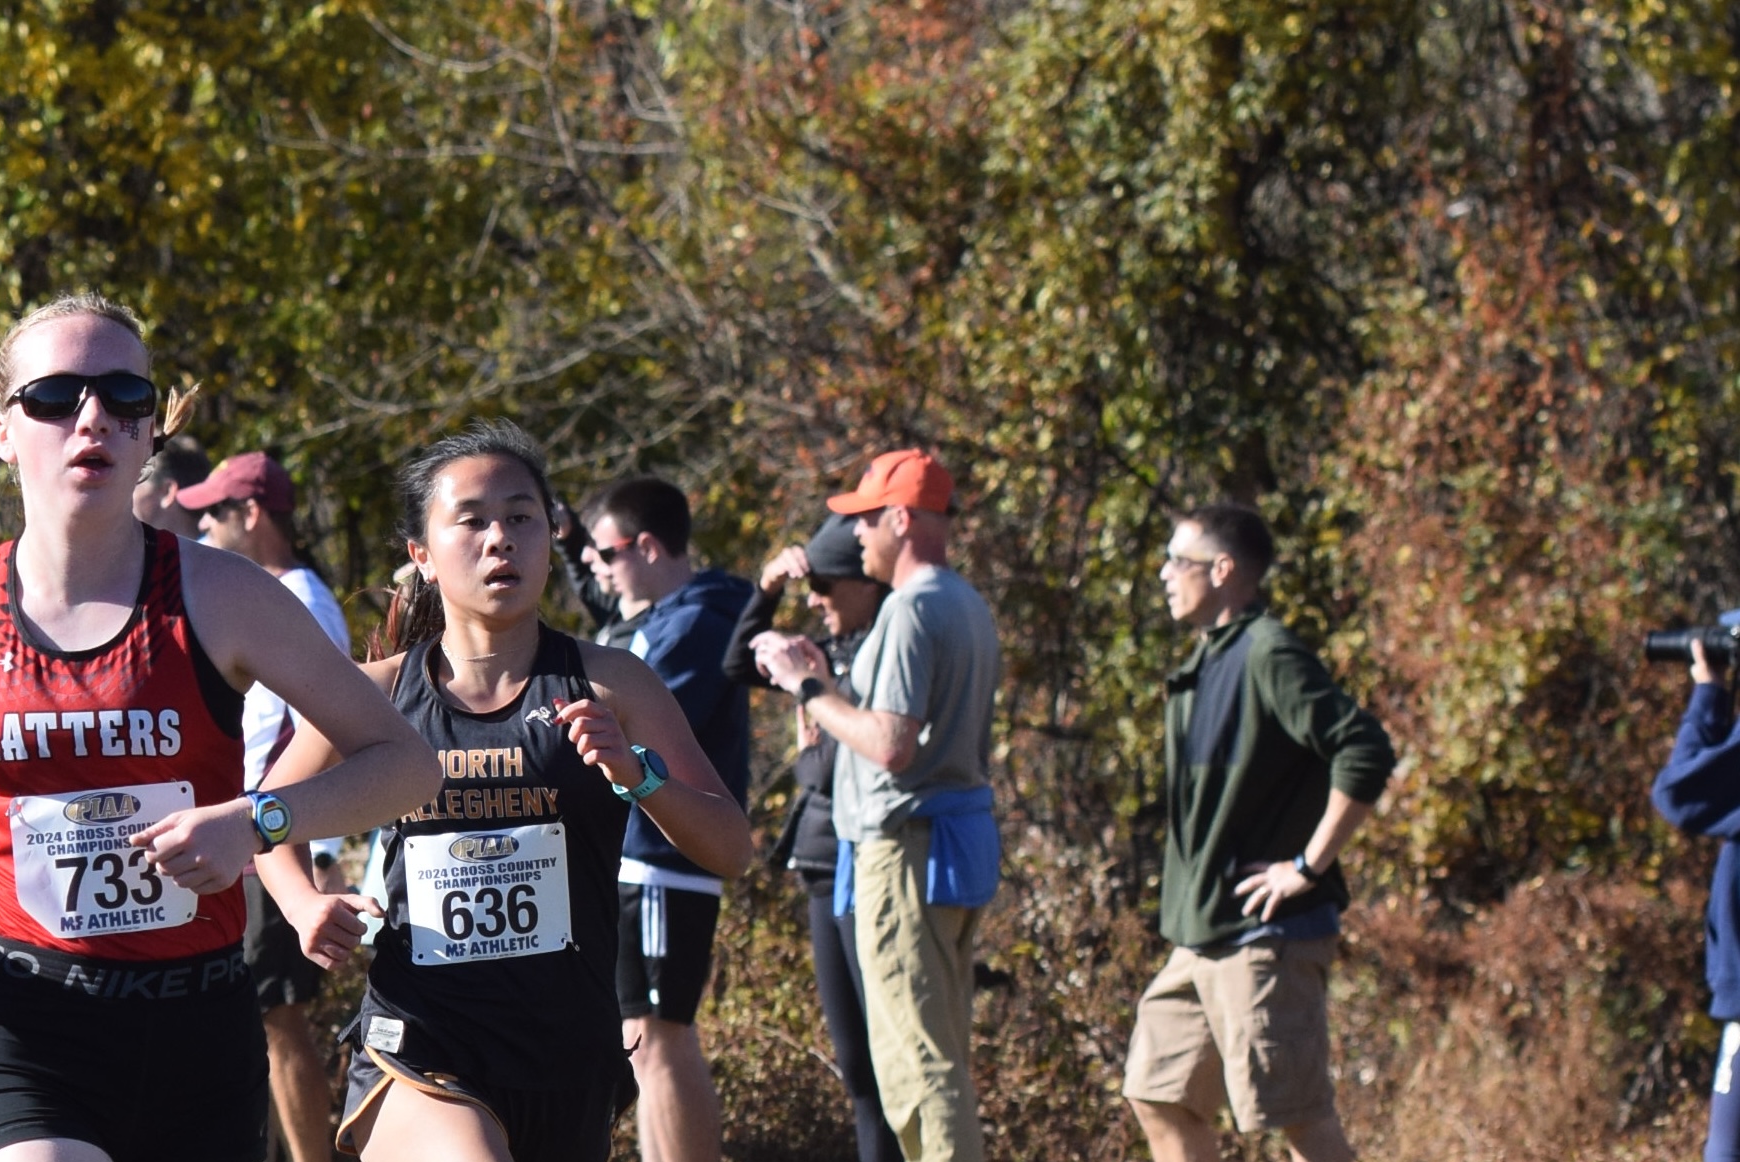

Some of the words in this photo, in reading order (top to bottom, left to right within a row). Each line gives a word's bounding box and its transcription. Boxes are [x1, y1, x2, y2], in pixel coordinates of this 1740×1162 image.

[74, 794, 137, 821] PIAA
[26, 831, 63, 846] 2024
[66, 826, 115, 842] CROSS
[47, 837, 133, 857] CHAMPIONS
[460, 837, 515, 859] PIAA
[55, 849, 163, 913] 733
[418, 868, 449, 881] 2024
[451, 864, 495, 878] CROSS
[497, 857, 557, 873] COUNTRY
[434, 870, 542, 890] CHAMPIONSHIPS
[87, 906, 166, 930] ATHLETIC
[441, 884, 539, 941] 636
[470, 934, 539, 955] ATHLETIC
[64, 964, 193, 1000] NIKE
[201, 951, 245, 992] PR
